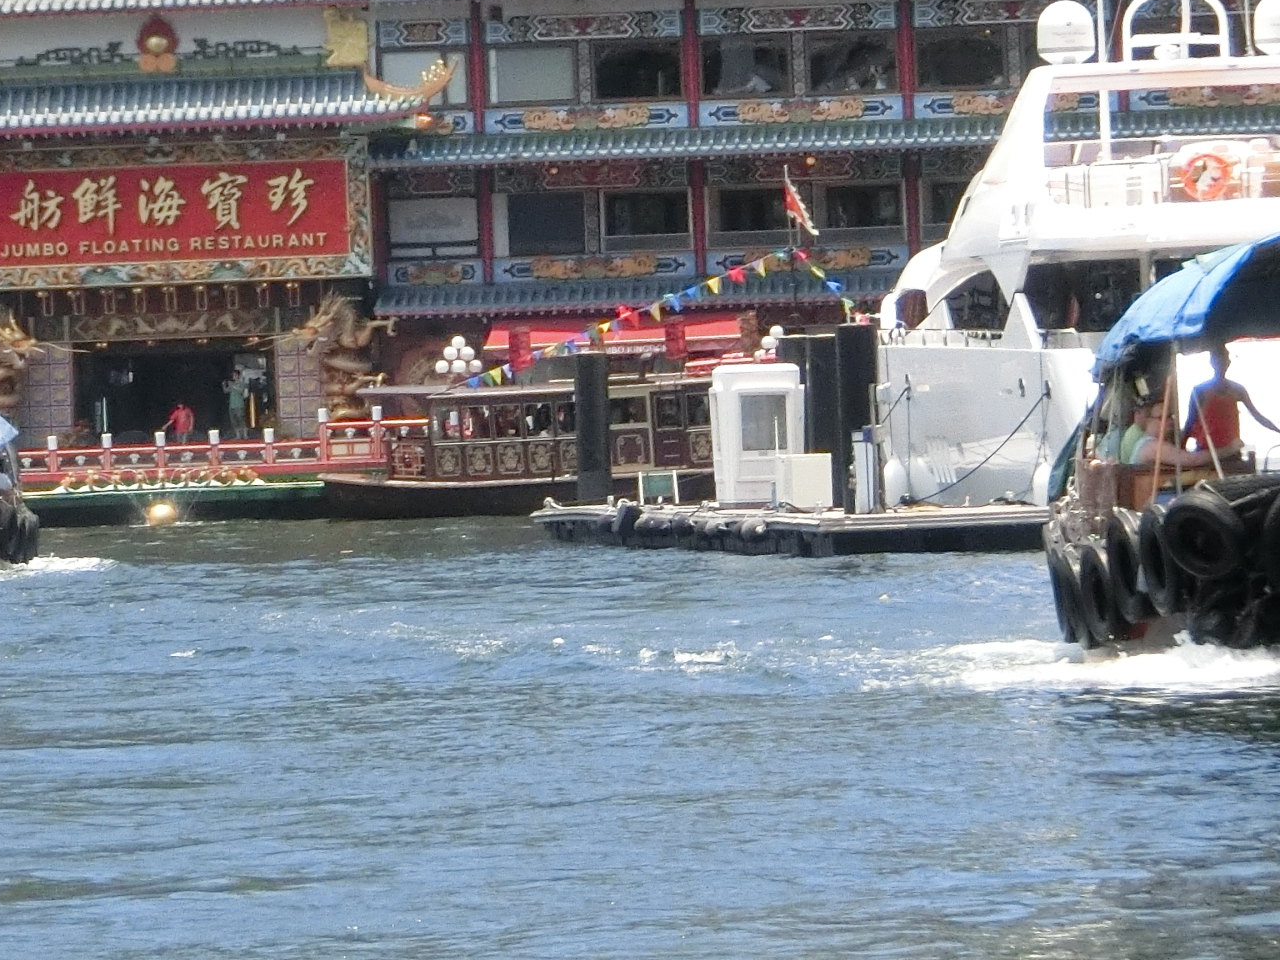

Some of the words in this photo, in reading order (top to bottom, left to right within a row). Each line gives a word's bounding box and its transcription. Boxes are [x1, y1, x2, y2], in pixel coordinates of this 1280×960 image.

[0, 243, 69, 258] JUMBO
[79, 237, 180, 256] FLOATING
[190, 232, 328, 251] RESTAURANT
